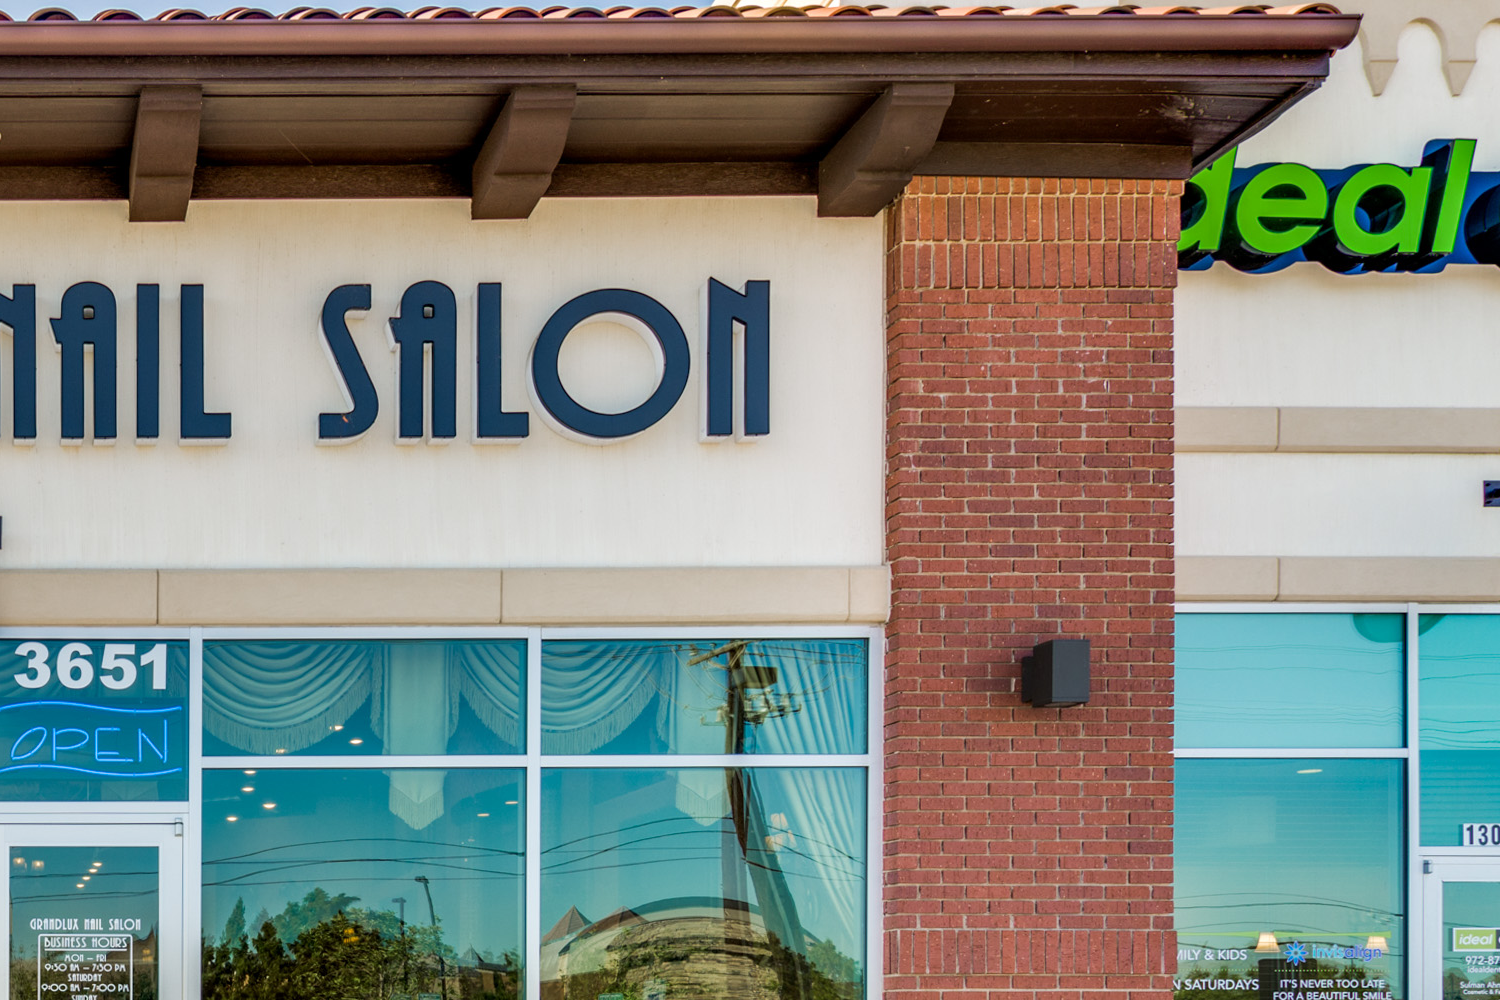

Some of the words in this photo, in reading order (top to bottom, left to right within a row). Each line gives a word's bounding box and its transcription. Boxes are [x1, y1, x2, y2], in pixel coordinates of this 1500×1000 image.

[315, 276, 771, 442] SALON
[13, 641, 168, 691] 3651
[10, 719, 168, 763] OPEN
[1466, 824, 1500, 846] 130
[29, 918, 79, 931] GRANDLUX
[84, 918, 104, 931] NAIL
[108, 918, 142, 931] SALON
[44, 937, 87, 948] BUSINESS
[91, 937, 128, 948] HOURS
[1459, 933, 1494, 945] ideal
[64, 954, 84, 962] MON
[96, 954, 107, 962] FRI
[1204, 949, 1214, 961] &
[1218, 949, 1248, 961] KIDS
[1312, 944, 1383, 962] invisalign
[70, 963, 80, 972] AM
[115, 963, 126, 972] PM
[67, 973, 103, 982] SATURDAY
[41, 984, 68, 993] 9:00
[70, 984, 80, 992] AM
[92, 983, 116, 993] 7:00
[118, 984, 129, 992] PM
[1185, 979, 1260, 991] SATURDAYS
[1280, 979, 1298, 989] IT'S
[1300, 979, 1334, 989] NEVER
[1336, 979, 1359, 989] TOO
[1361, 979, 1386, 989] LATE
[1273, 992, 1294, 1000] FOR
[1296, 992, 1304, 1000] A
[1306, 992, 1361, 1000] BEAUTIFUL
[1362, 992, 1393, 1000] SMILE
